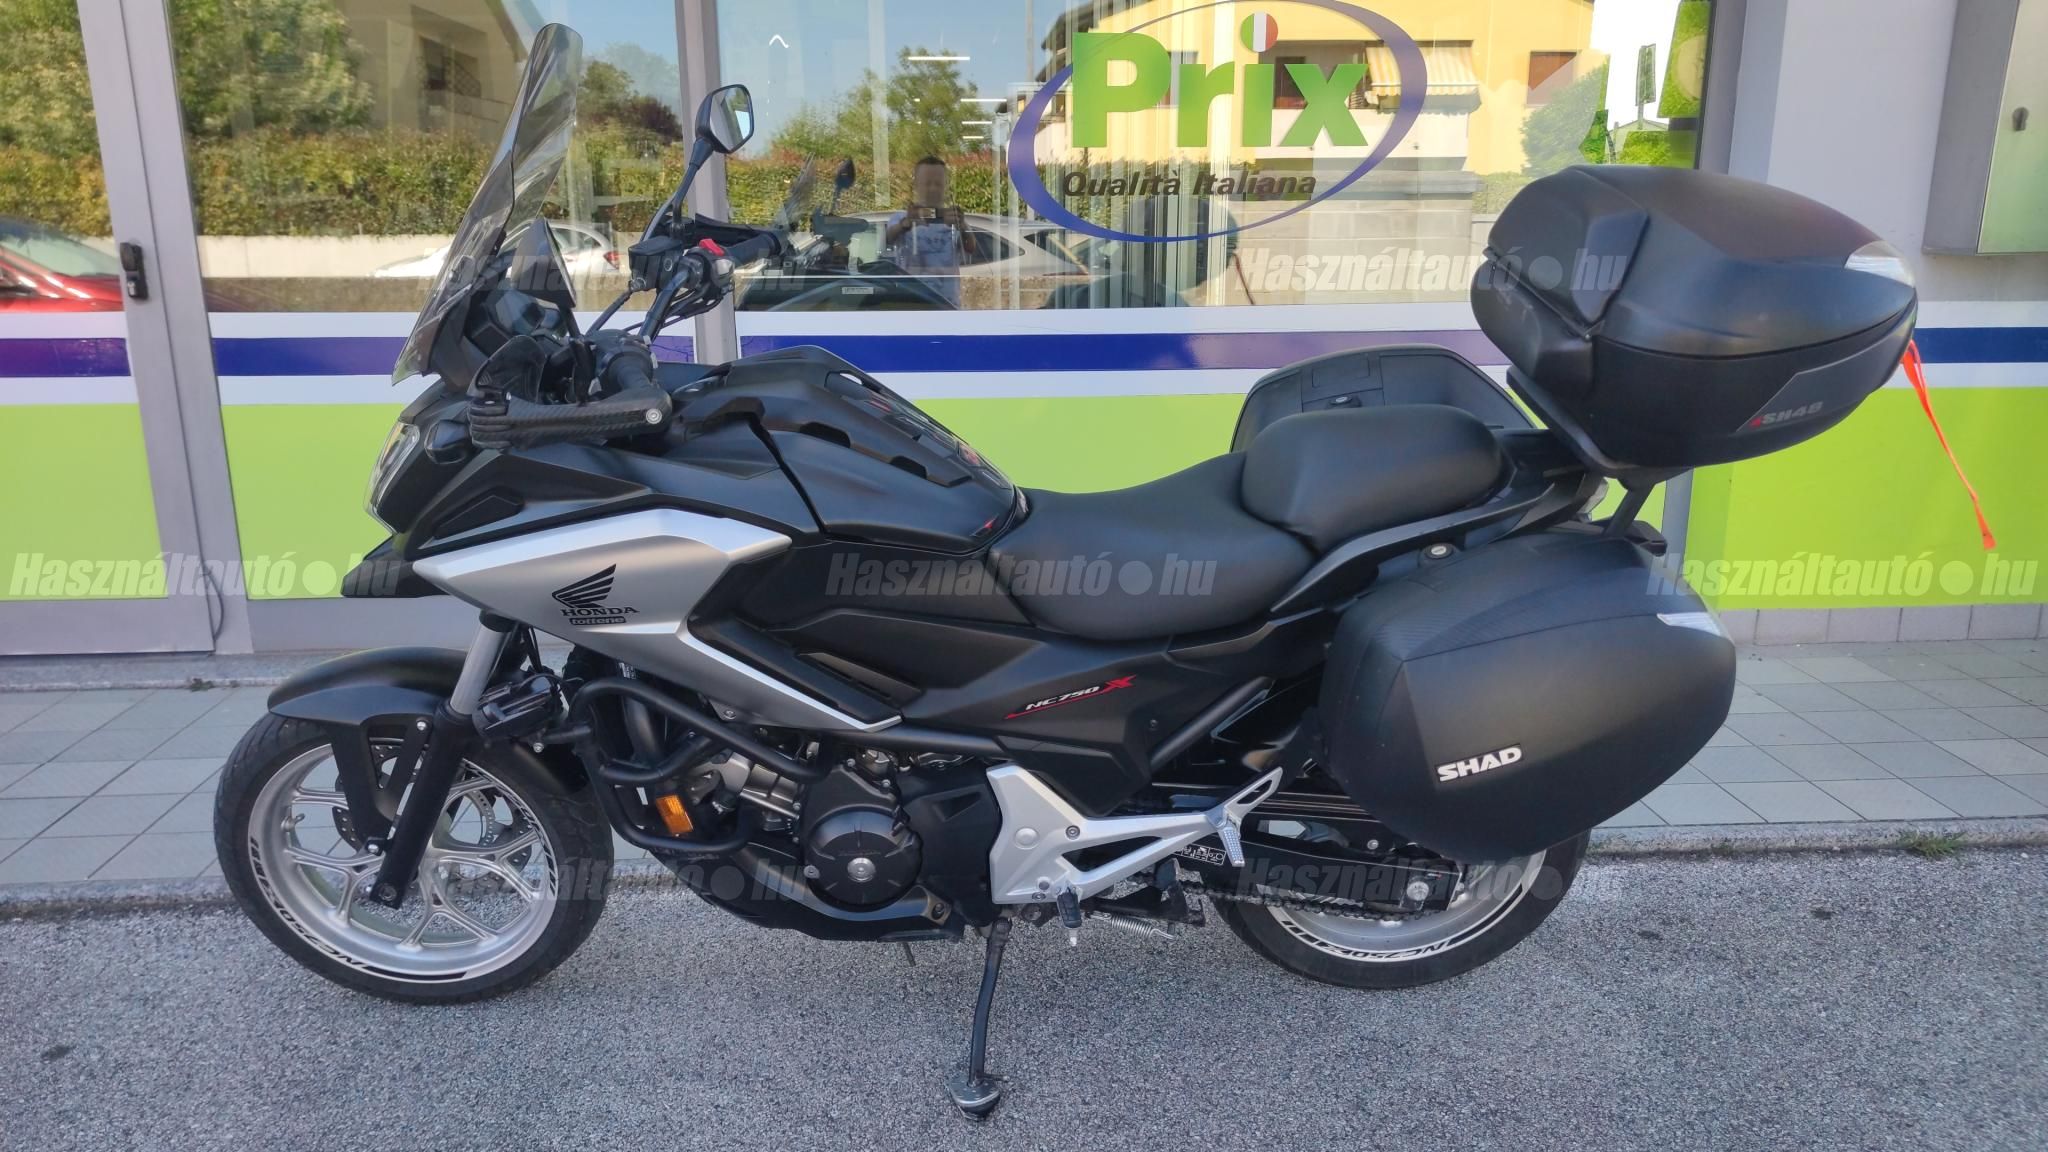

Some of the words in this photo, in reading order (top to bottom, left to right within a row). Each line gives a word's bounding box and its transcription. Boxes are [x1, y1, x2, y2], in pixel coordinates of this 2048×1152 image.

[1071, 12, 1370, 148] Prix
[1062, 170, 1181, 198] Qualità
[1193, 170, 1317, 196] Italiana
[561, 606, 640, 616] HONDA
[1437, 747, 1523, 782] SHAD
